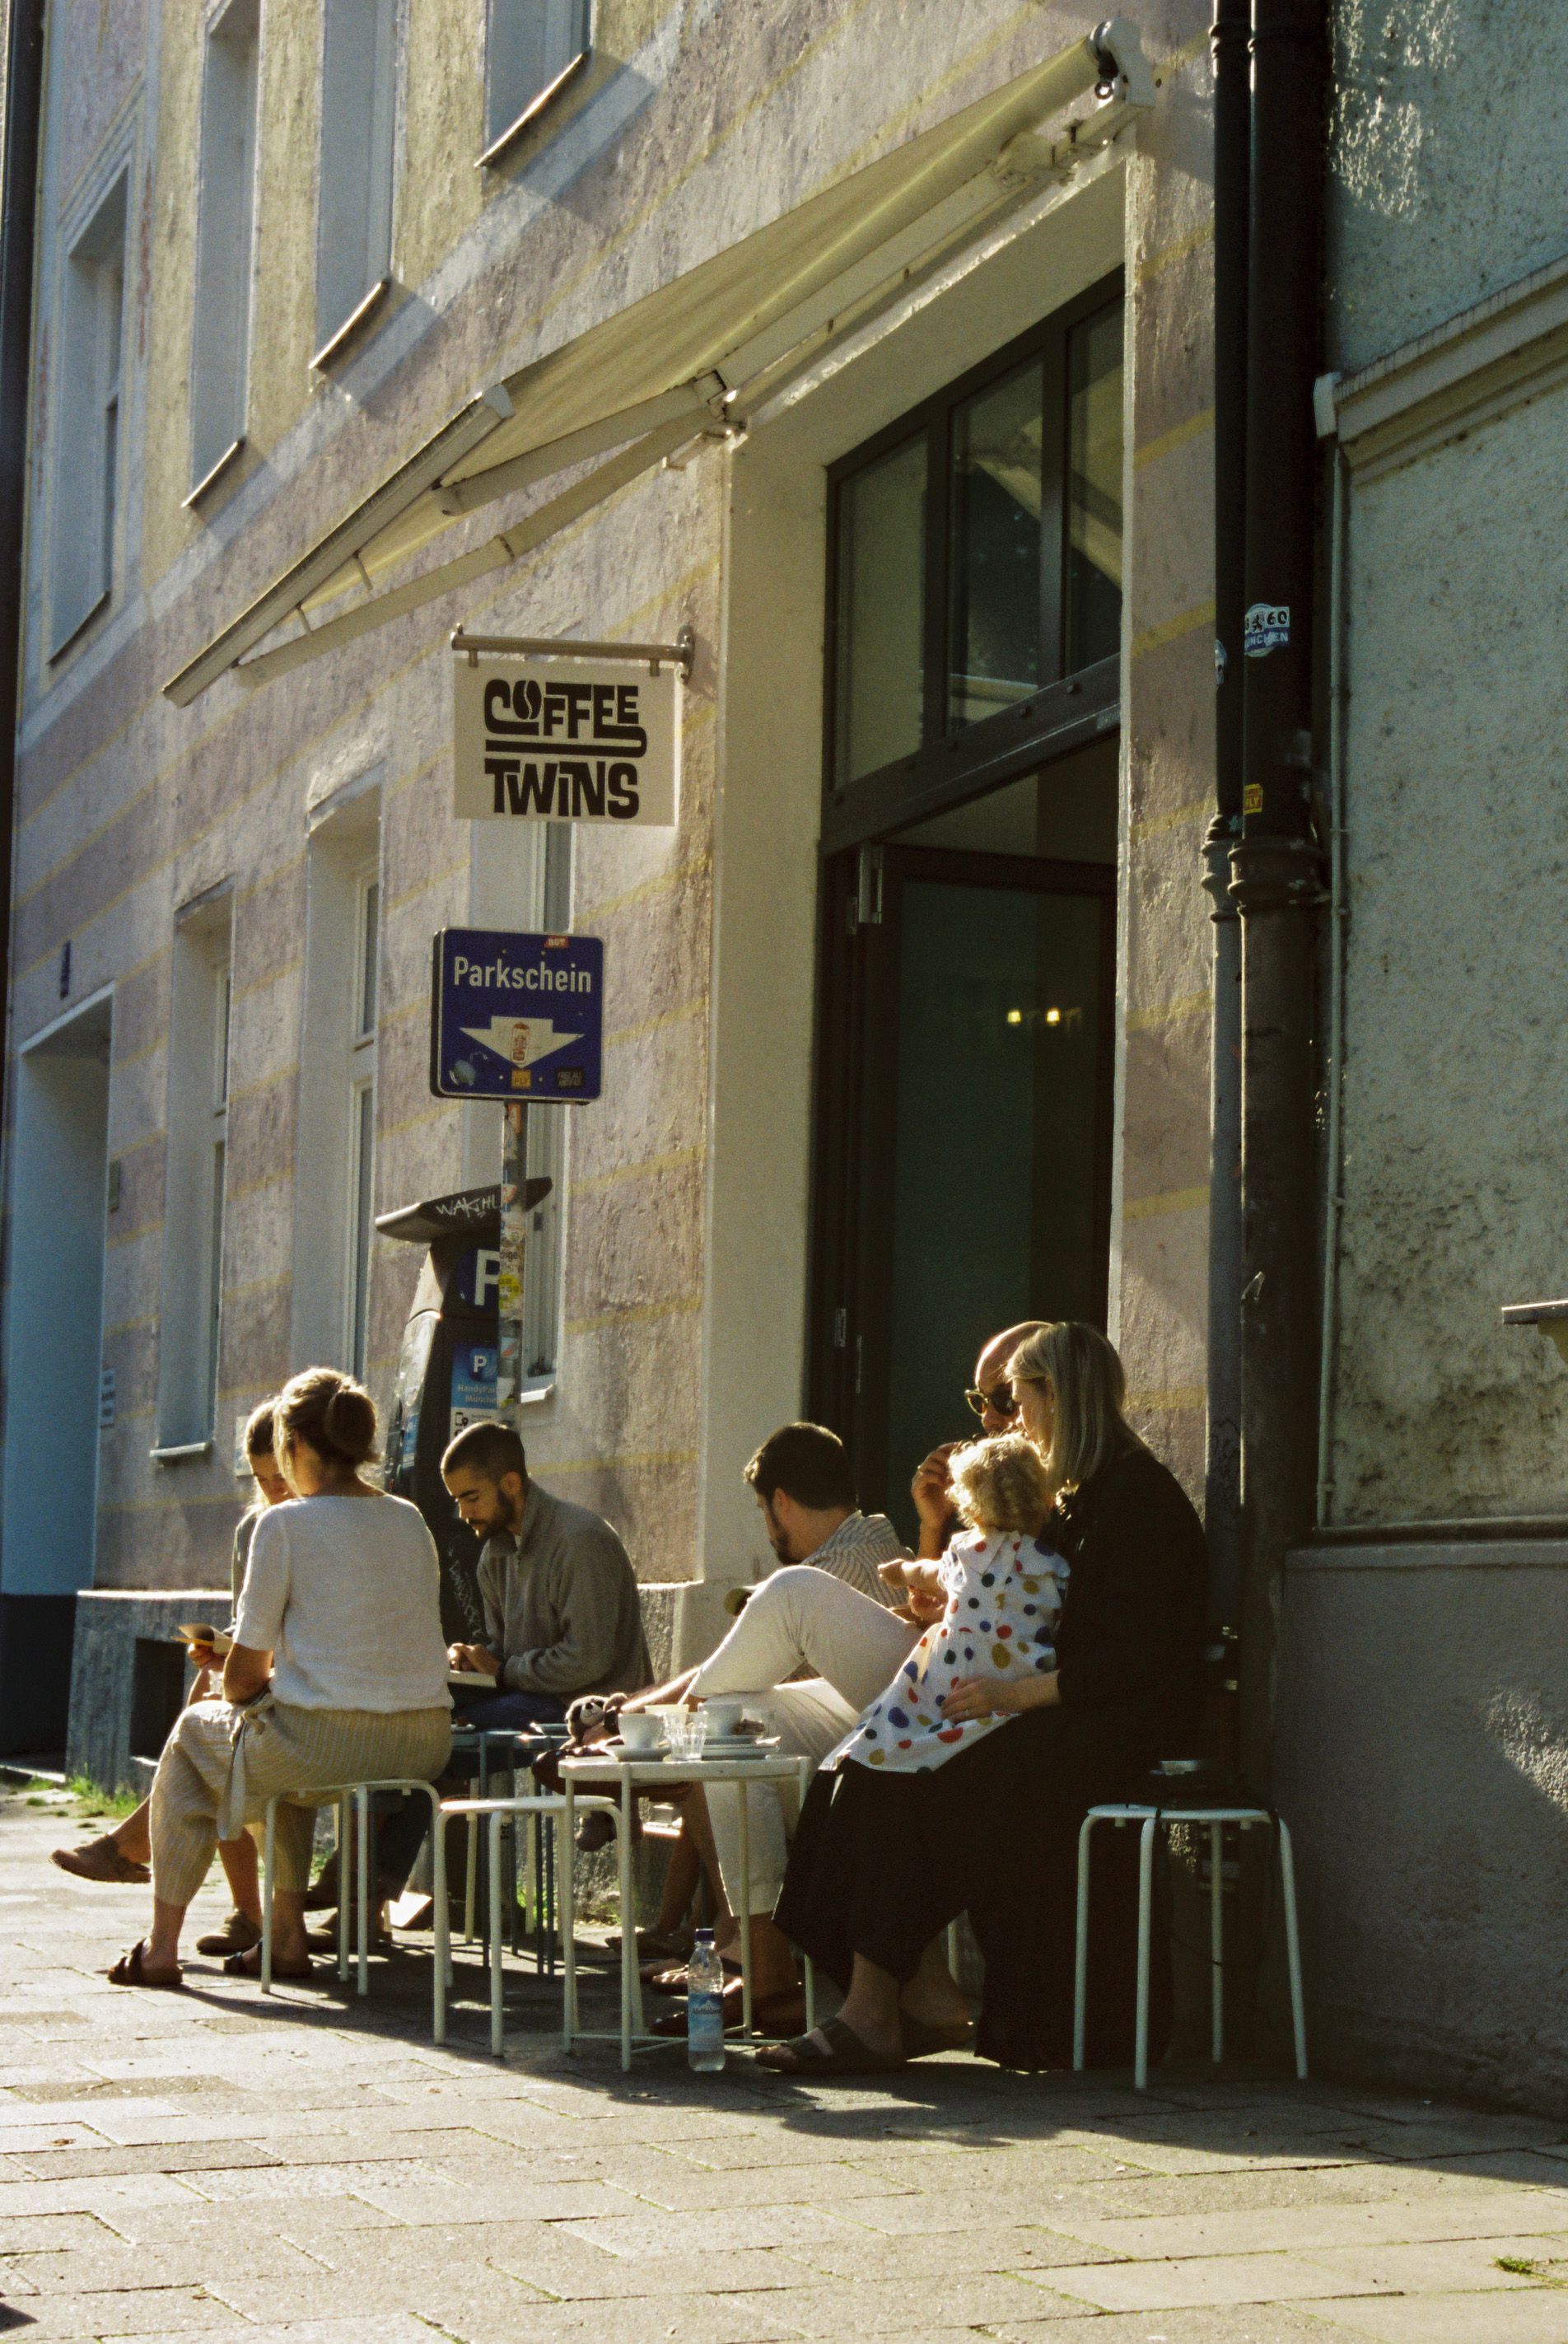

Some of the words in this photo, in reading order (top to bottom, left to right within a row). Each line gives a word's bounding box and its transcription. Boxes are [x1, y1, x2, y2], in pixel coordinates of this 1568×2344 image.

[484, 679, 647, 758] COFFEE
[484, 758, 640, 819] TWINS
[454, 956, 592, 993] Parkschein
[474, 1355, 488, 1373] P
[458, 1384, 497, 1395] HandyPar
